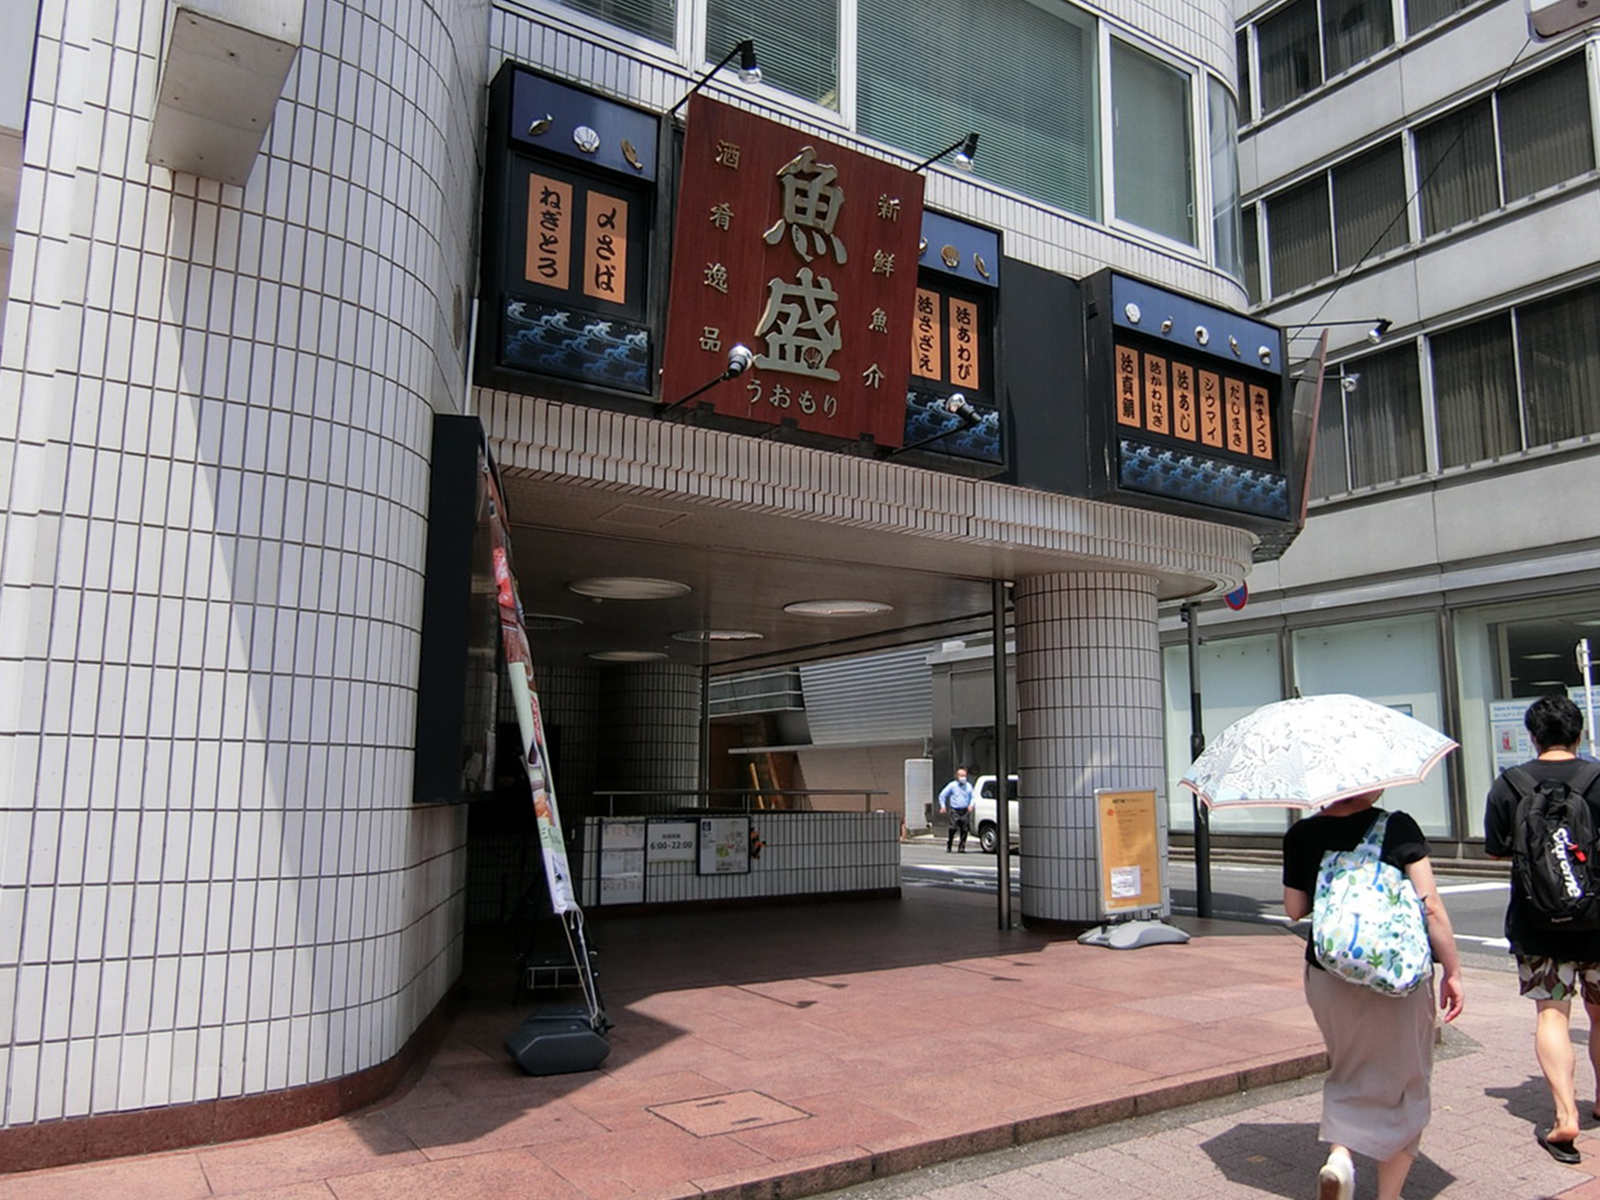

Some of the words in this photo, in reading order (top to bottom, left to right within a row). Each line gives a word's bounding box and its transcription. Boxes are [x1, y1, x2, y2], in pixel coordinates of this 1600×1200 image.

[538, 185, 562, 279] ねぎとろ
[699, 139, 741, 353] 酒肴逸品
[753, 145, 847, 382] 魚盛
[860, 193, 901, 391] 新鮮魚介
[917, 294, 934, 373] 活さざえ
[956, 305, 973, 380] 活あわび
[746, 379, 838, 418] うおもり
[1177, 368, 1190, 433] 活あじ
[1204, 377, 1216, 441] シウマイ
[1230, 385, 1242, 447] だしまき
